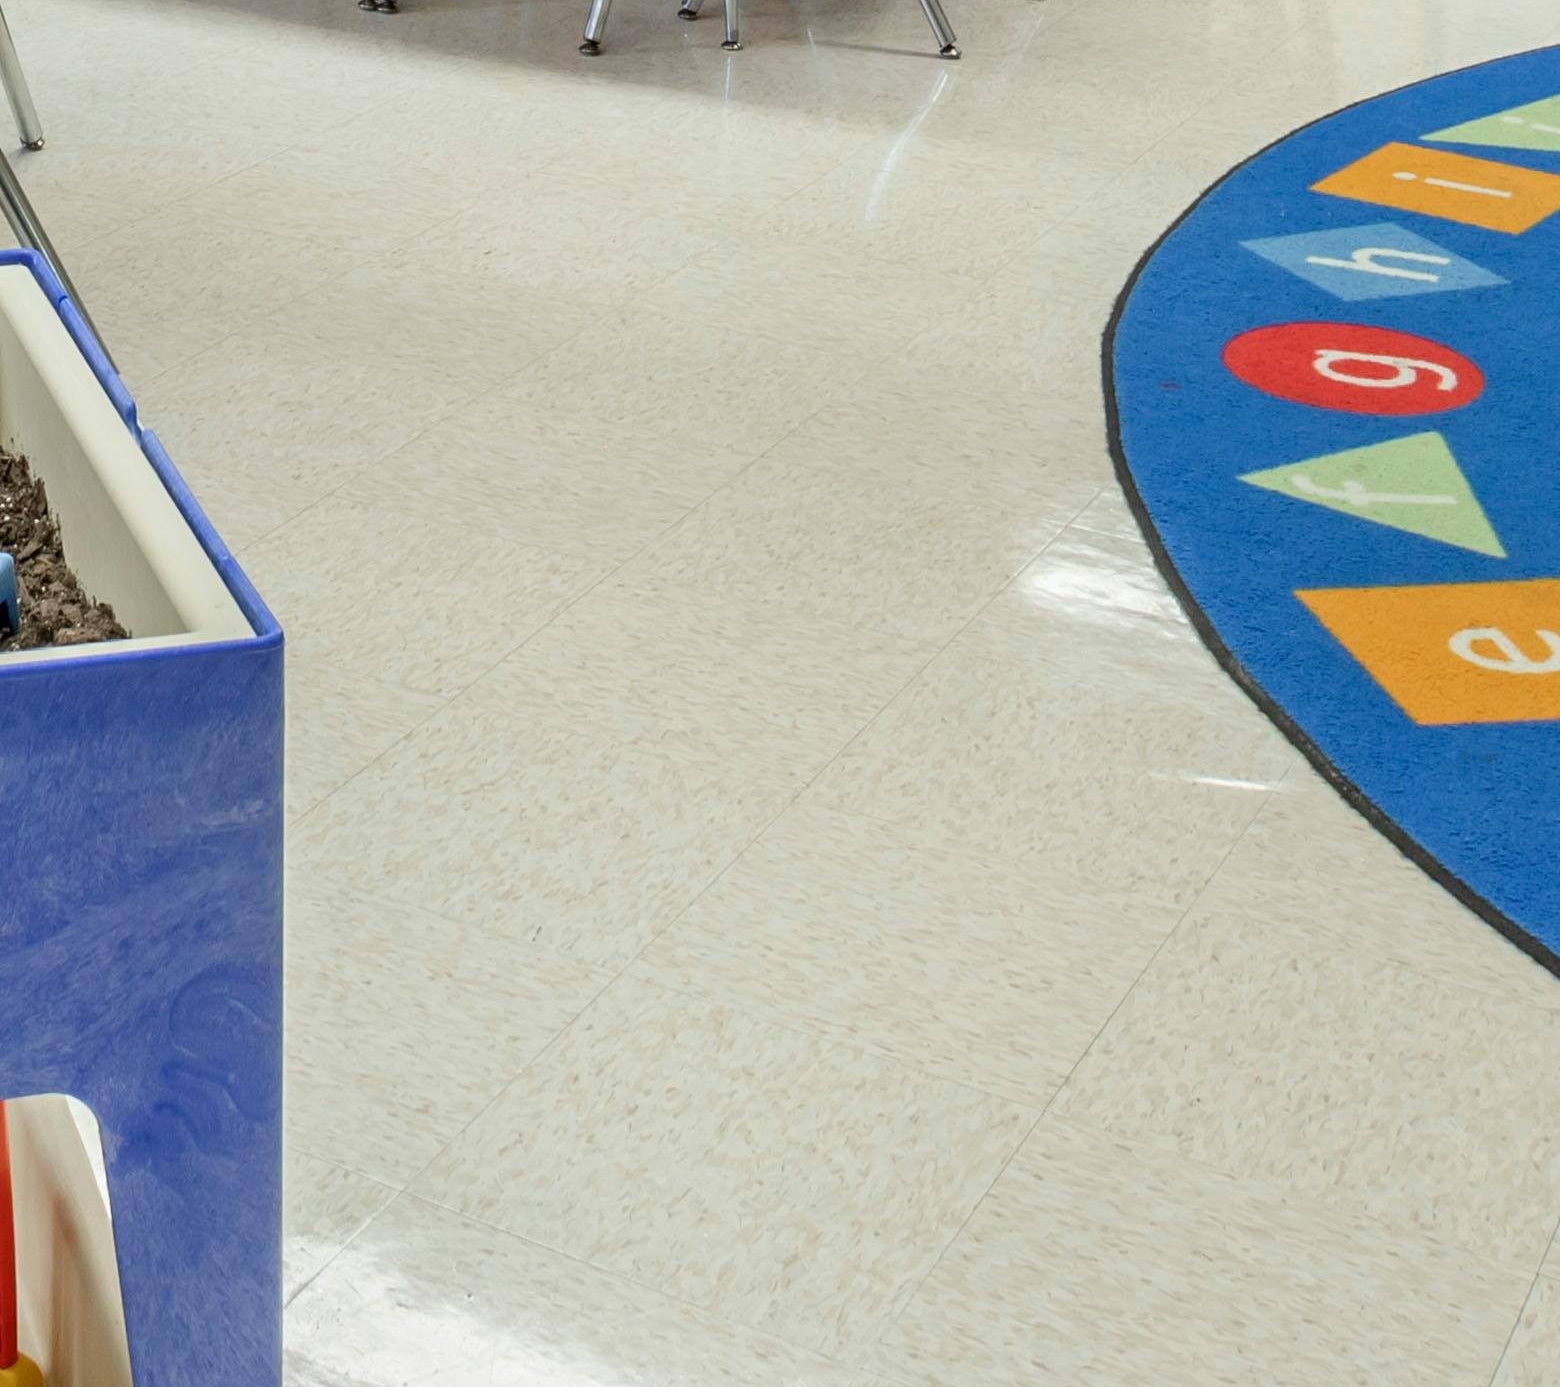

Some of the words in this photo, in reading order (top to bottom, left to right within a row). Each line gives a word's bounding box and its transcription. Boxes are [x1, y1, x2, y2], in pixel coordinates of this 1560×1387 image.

[1393, 170, 1512, 199] i
[1305, 247, 1451, 283] h
[1314, 349, 1457, 391] g
[1291, 473, 1459, 508] f
